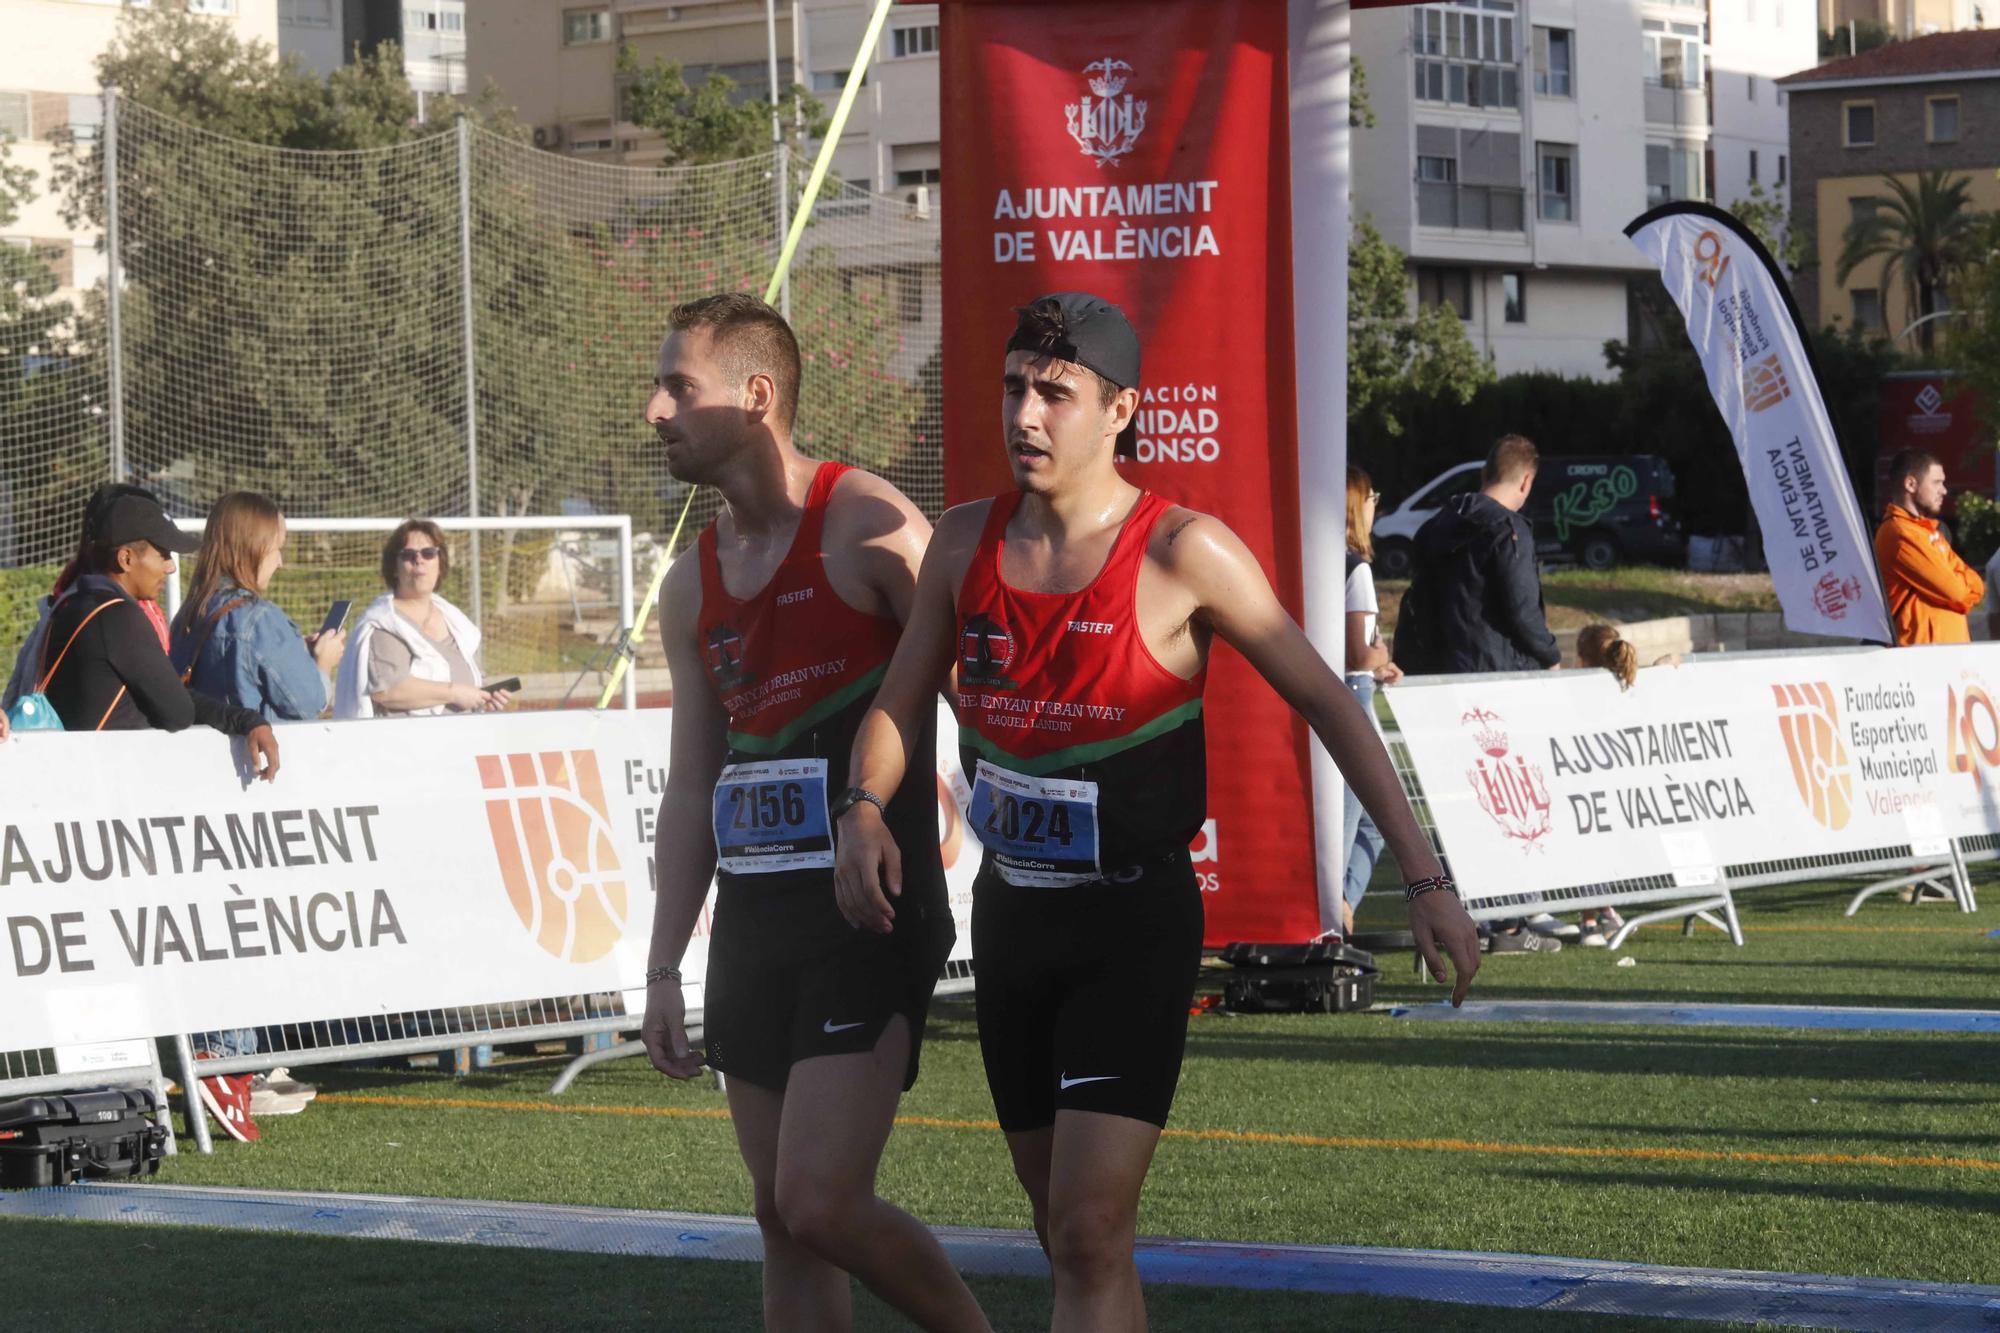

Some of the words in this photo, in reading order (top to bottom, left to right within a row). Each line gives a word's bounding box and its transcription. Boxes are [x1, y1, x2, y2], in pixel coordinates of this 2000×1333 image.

[993, 181, 1218, 220] AJUNTAMENT
[994, 232, 1035, 263] DE
[1048, 221, 1220, 262] VALÈNCIA
[1143, 383, 1217, 403] ACIÓN
[1136, 408, 1219, 435] NIDAD
[1137, 437, 1220, 463] ONSO
[777, 587, 814, 607] FASTER
[1067, 620, 1114, 634] FASTER
[810, 659, 848, 679] WAY
[1034, 701, 1083, 719] URBAN
[1086, 705, 1126, 722] WAY
[1844, 681, 1916, 713] Fundació
[987, 714, 1028, 729] RAQUEL
[1030, 718, 1072, 732] LANDIN
[1850, 715, 1928, 753] Esportiva
[1549, 718, 1733, 777] AJUNTAMENT
[1859, 747, 1938, 783] Municipal
[730, 782, 805, 829] 2156
[984, 788, 1074, 848] 2024
[1567, 791, 1612, 835] DE
[1616, 773, 1756, 830] VALÈNCIA
[0, 804, 380, 886] AJUNTAMENT
[6, 911, 96, 977] DE
[109, 883, 409, 968] VALÈNCIA
